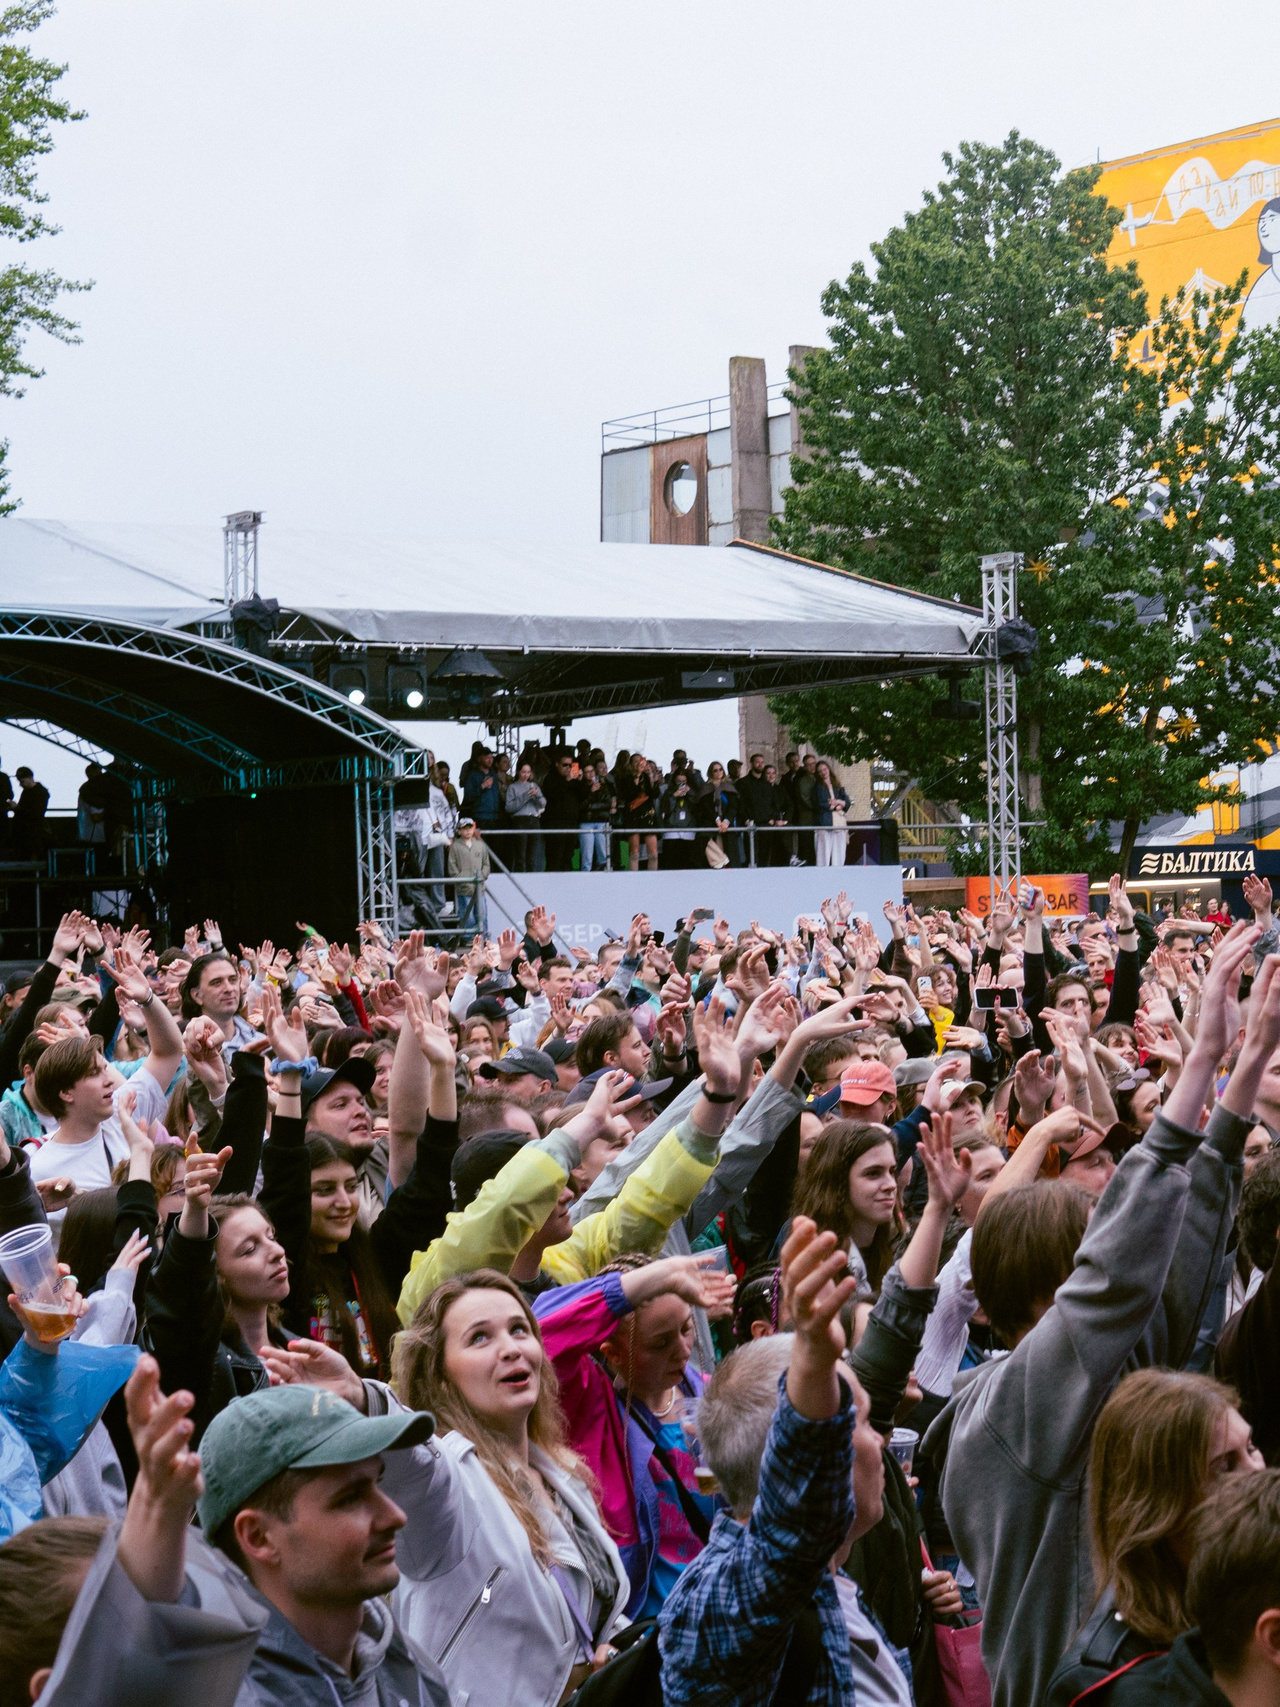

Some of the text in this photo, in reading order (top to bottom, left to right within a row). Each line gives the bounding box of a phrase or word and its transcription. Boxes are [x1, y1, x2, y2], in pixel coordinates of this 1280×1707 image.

[1159, 850, 1256, 874] БАЛТИКА
[1047, 893, 1079, 911] BAR
[551, 923, 603, 943] БЕР
